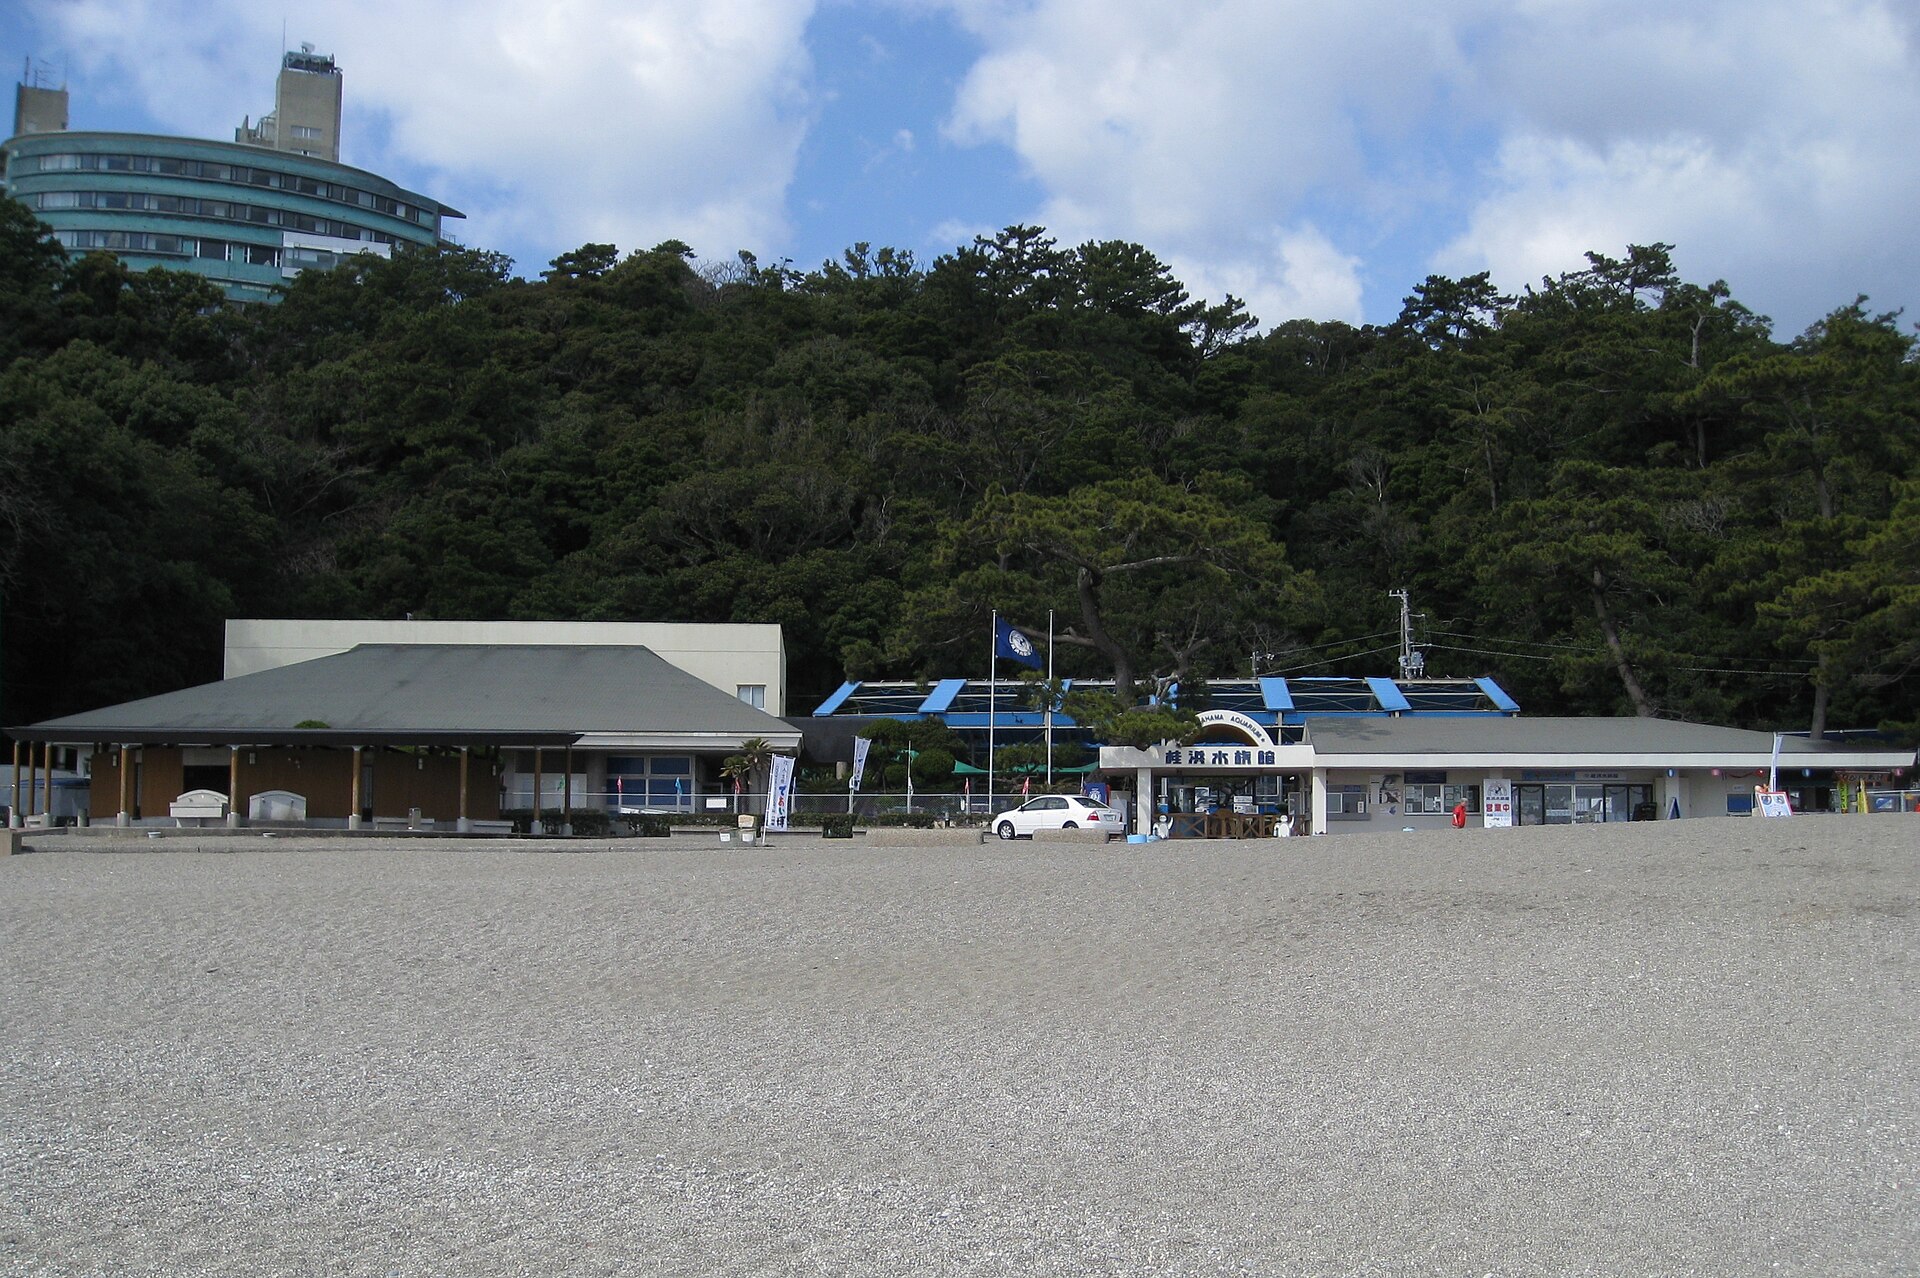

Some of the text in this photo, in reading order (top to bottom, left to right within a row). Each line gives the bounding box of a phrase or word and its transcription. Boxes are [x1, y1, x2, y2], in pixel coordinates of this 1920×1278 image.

[1201, 714, 1262, 738] AHAMA AQUARIUM
[1165, 750, 1275, 765] 桂浜水族館
